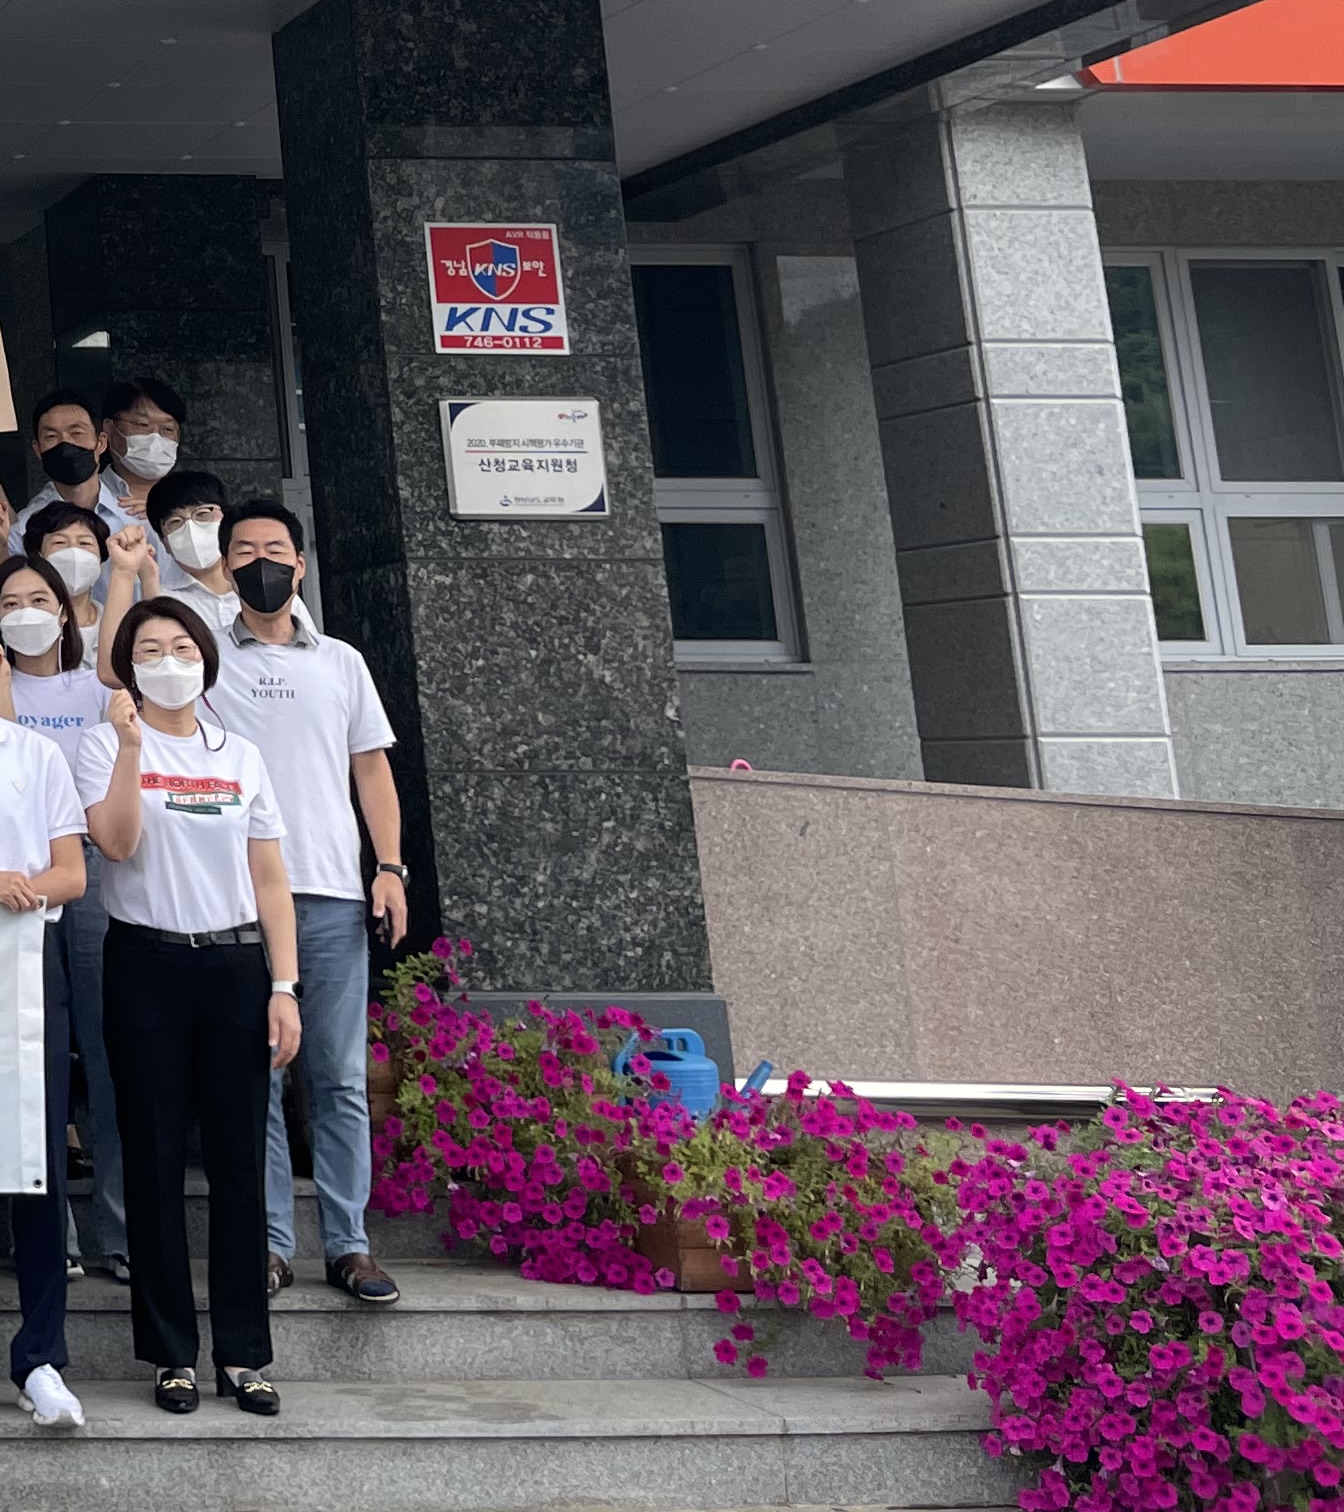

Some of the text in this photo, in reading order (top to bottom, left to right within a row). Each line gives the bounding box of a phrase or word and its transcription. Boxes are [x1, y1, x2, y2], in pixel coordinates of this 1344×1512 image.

[440, 259, 548, 278] 경남 KNS 보안
[444, 306, 556, 335] KNS
[463, 336, 543, 349] 746-0112
[478, 457, 578, 474] 산청교육지원청
[251, 689, 296, 700] YOUTH
[17, 714, 85, 730] oyager
